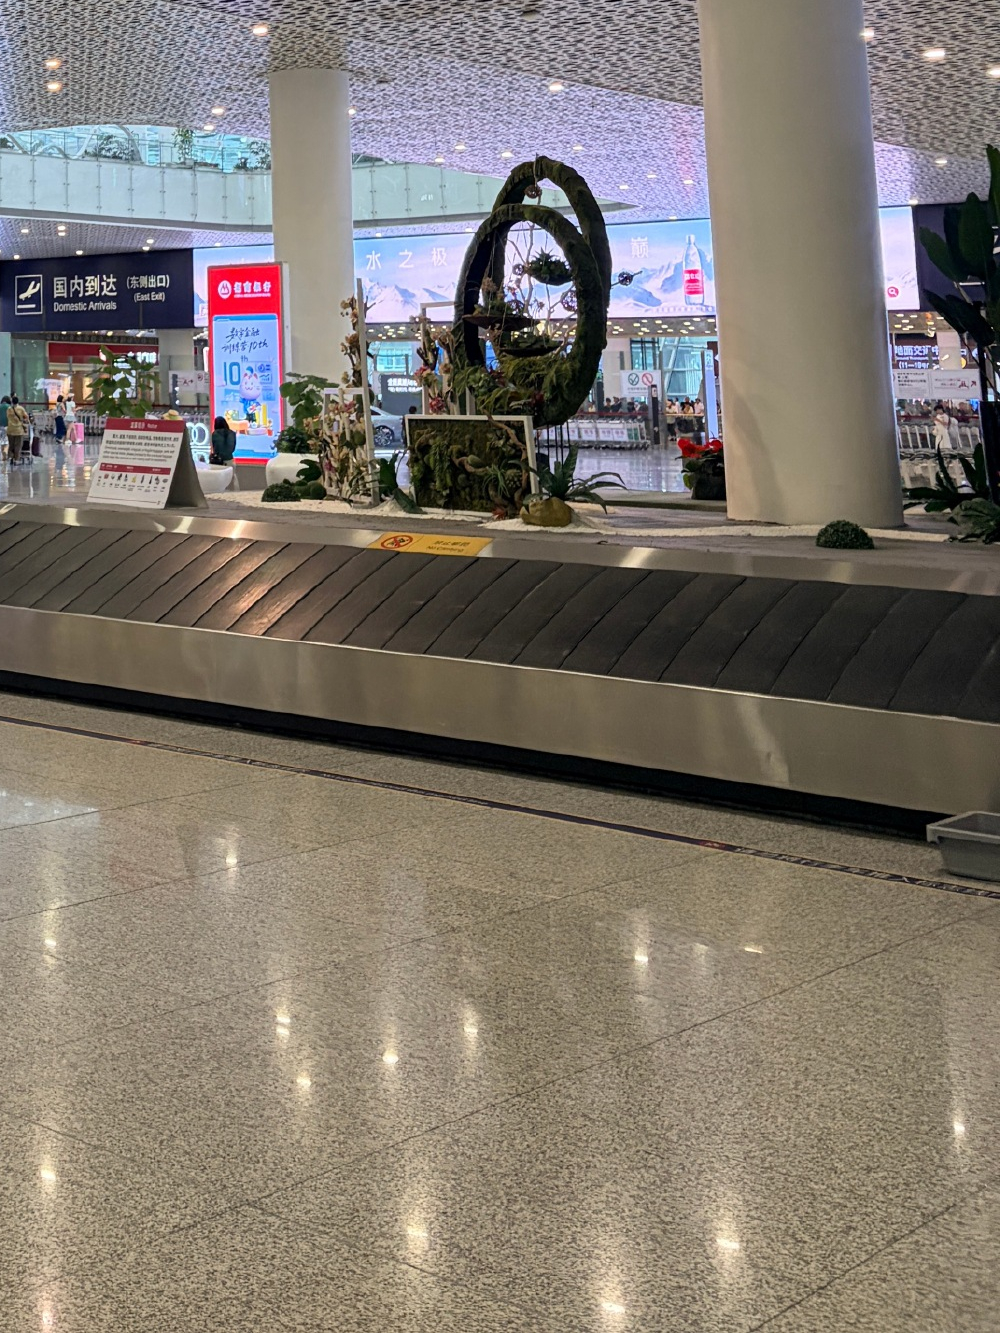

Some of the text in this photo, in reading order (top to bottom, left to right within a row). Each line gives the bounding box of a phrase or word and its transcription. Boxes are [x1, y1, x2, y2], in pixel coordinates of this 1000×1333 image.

[365, 247, 448, 271] 水之极
[53, 274, 170, 299] 国内到达 (东侧出口)
[53, 300, 117, 312] Domestic Arrivals
[134, 292, 166, 303] (East Exit)
